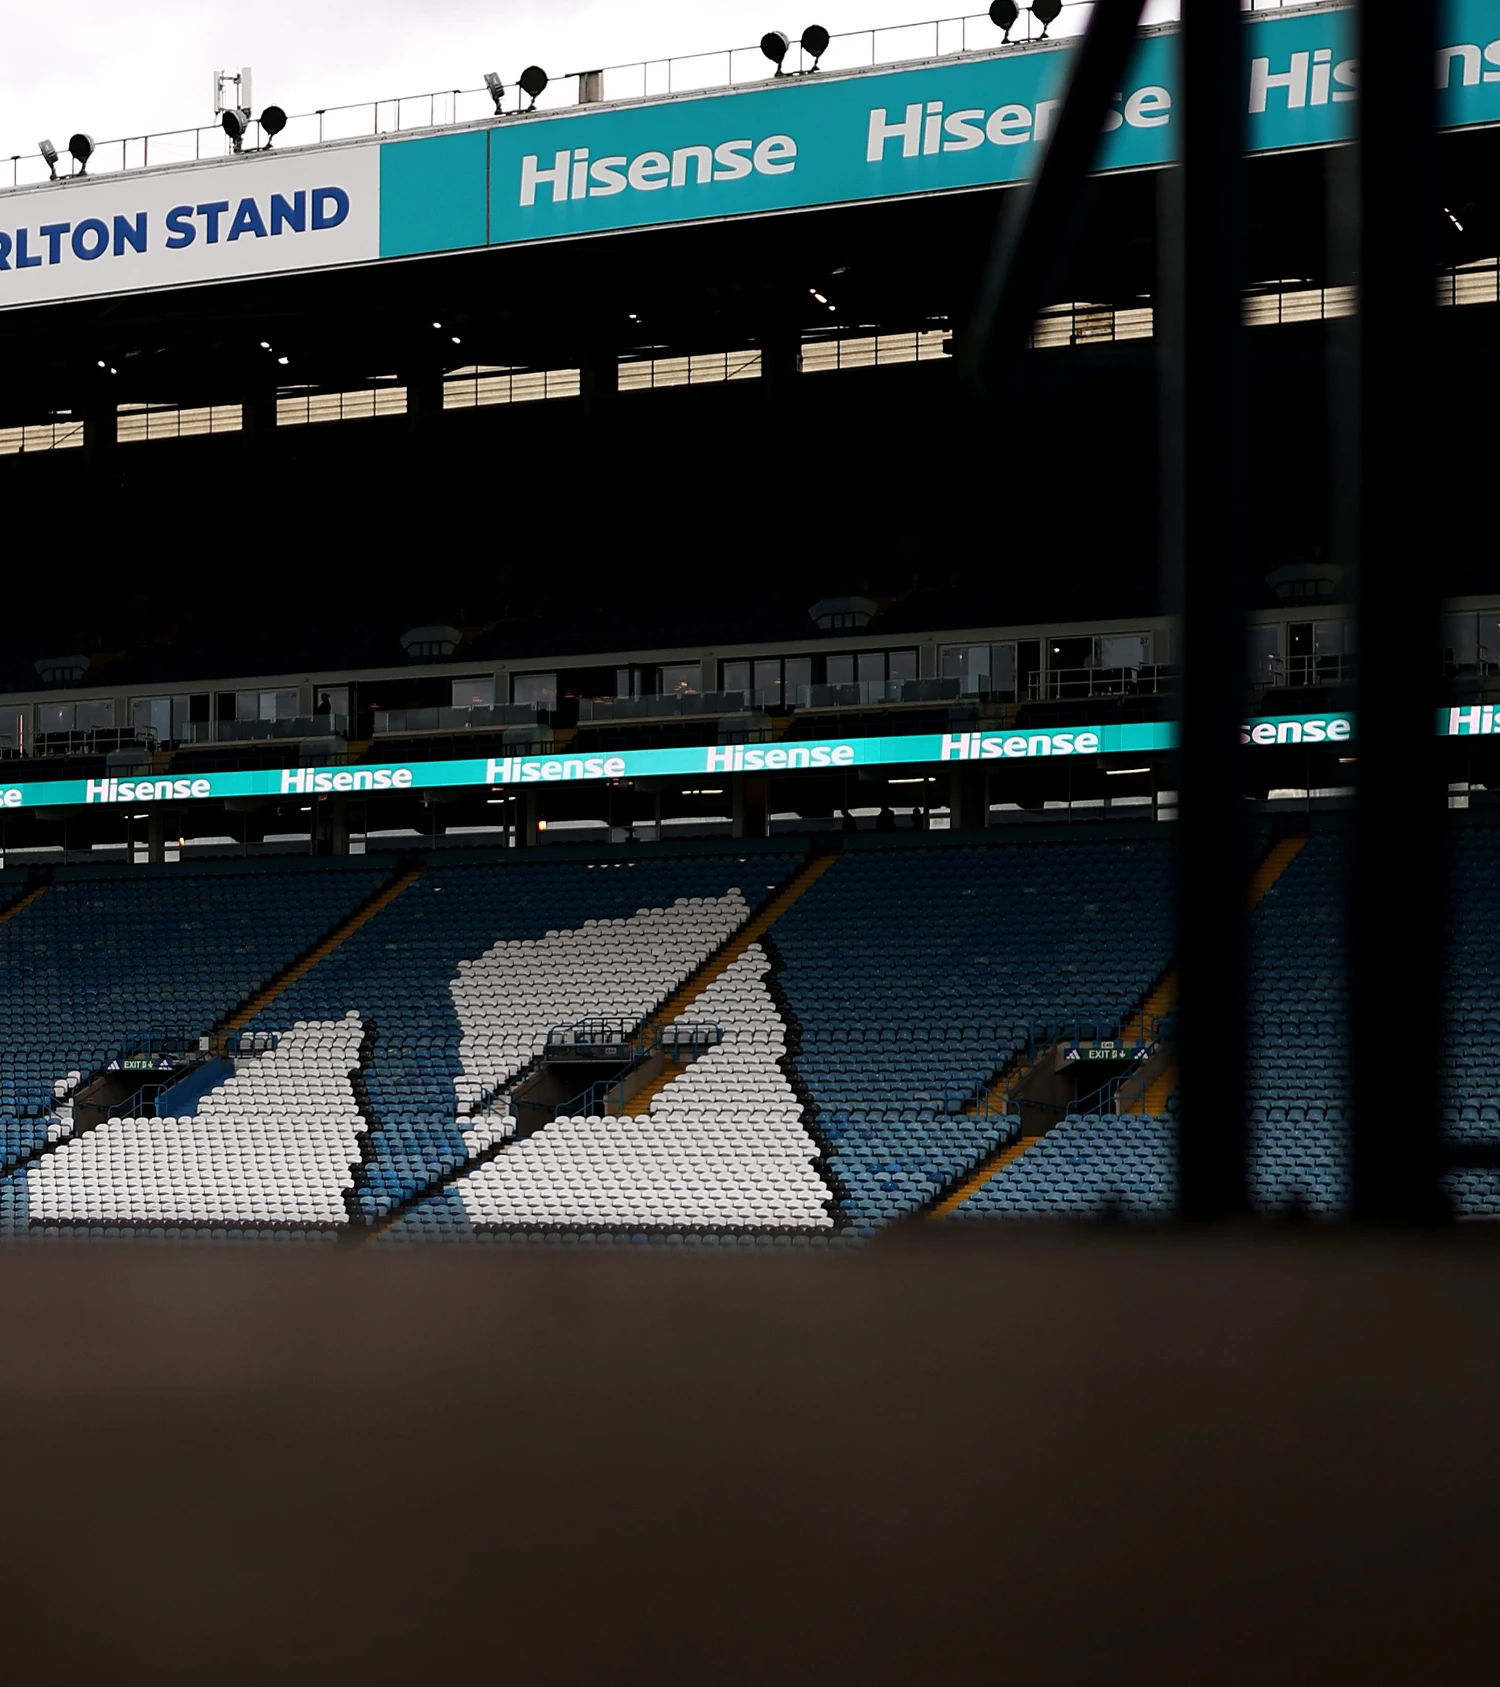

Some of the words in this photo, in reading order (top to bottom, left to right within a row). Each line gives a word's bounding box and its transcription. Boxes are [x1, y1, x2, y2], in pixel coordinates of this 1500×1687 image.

[1248, 38, 1500, 114] Hisn
[519, 134, 797, 207] Hisense
[165, 186, 350, 250] STAND
[940, 731, 1099, 760] Hisense
[1234, 719, 1351, 745] sense
[485, 755, 625, 784] Hisense
[705, 744, 855, 772] Hisense
[85, 777, 211, 803] Hisense
[280, 767, 413, 794] Hisense
[123, 1060, 141, 1069] EXIT
[1088, 1050, 1110, 1059] EXIT
